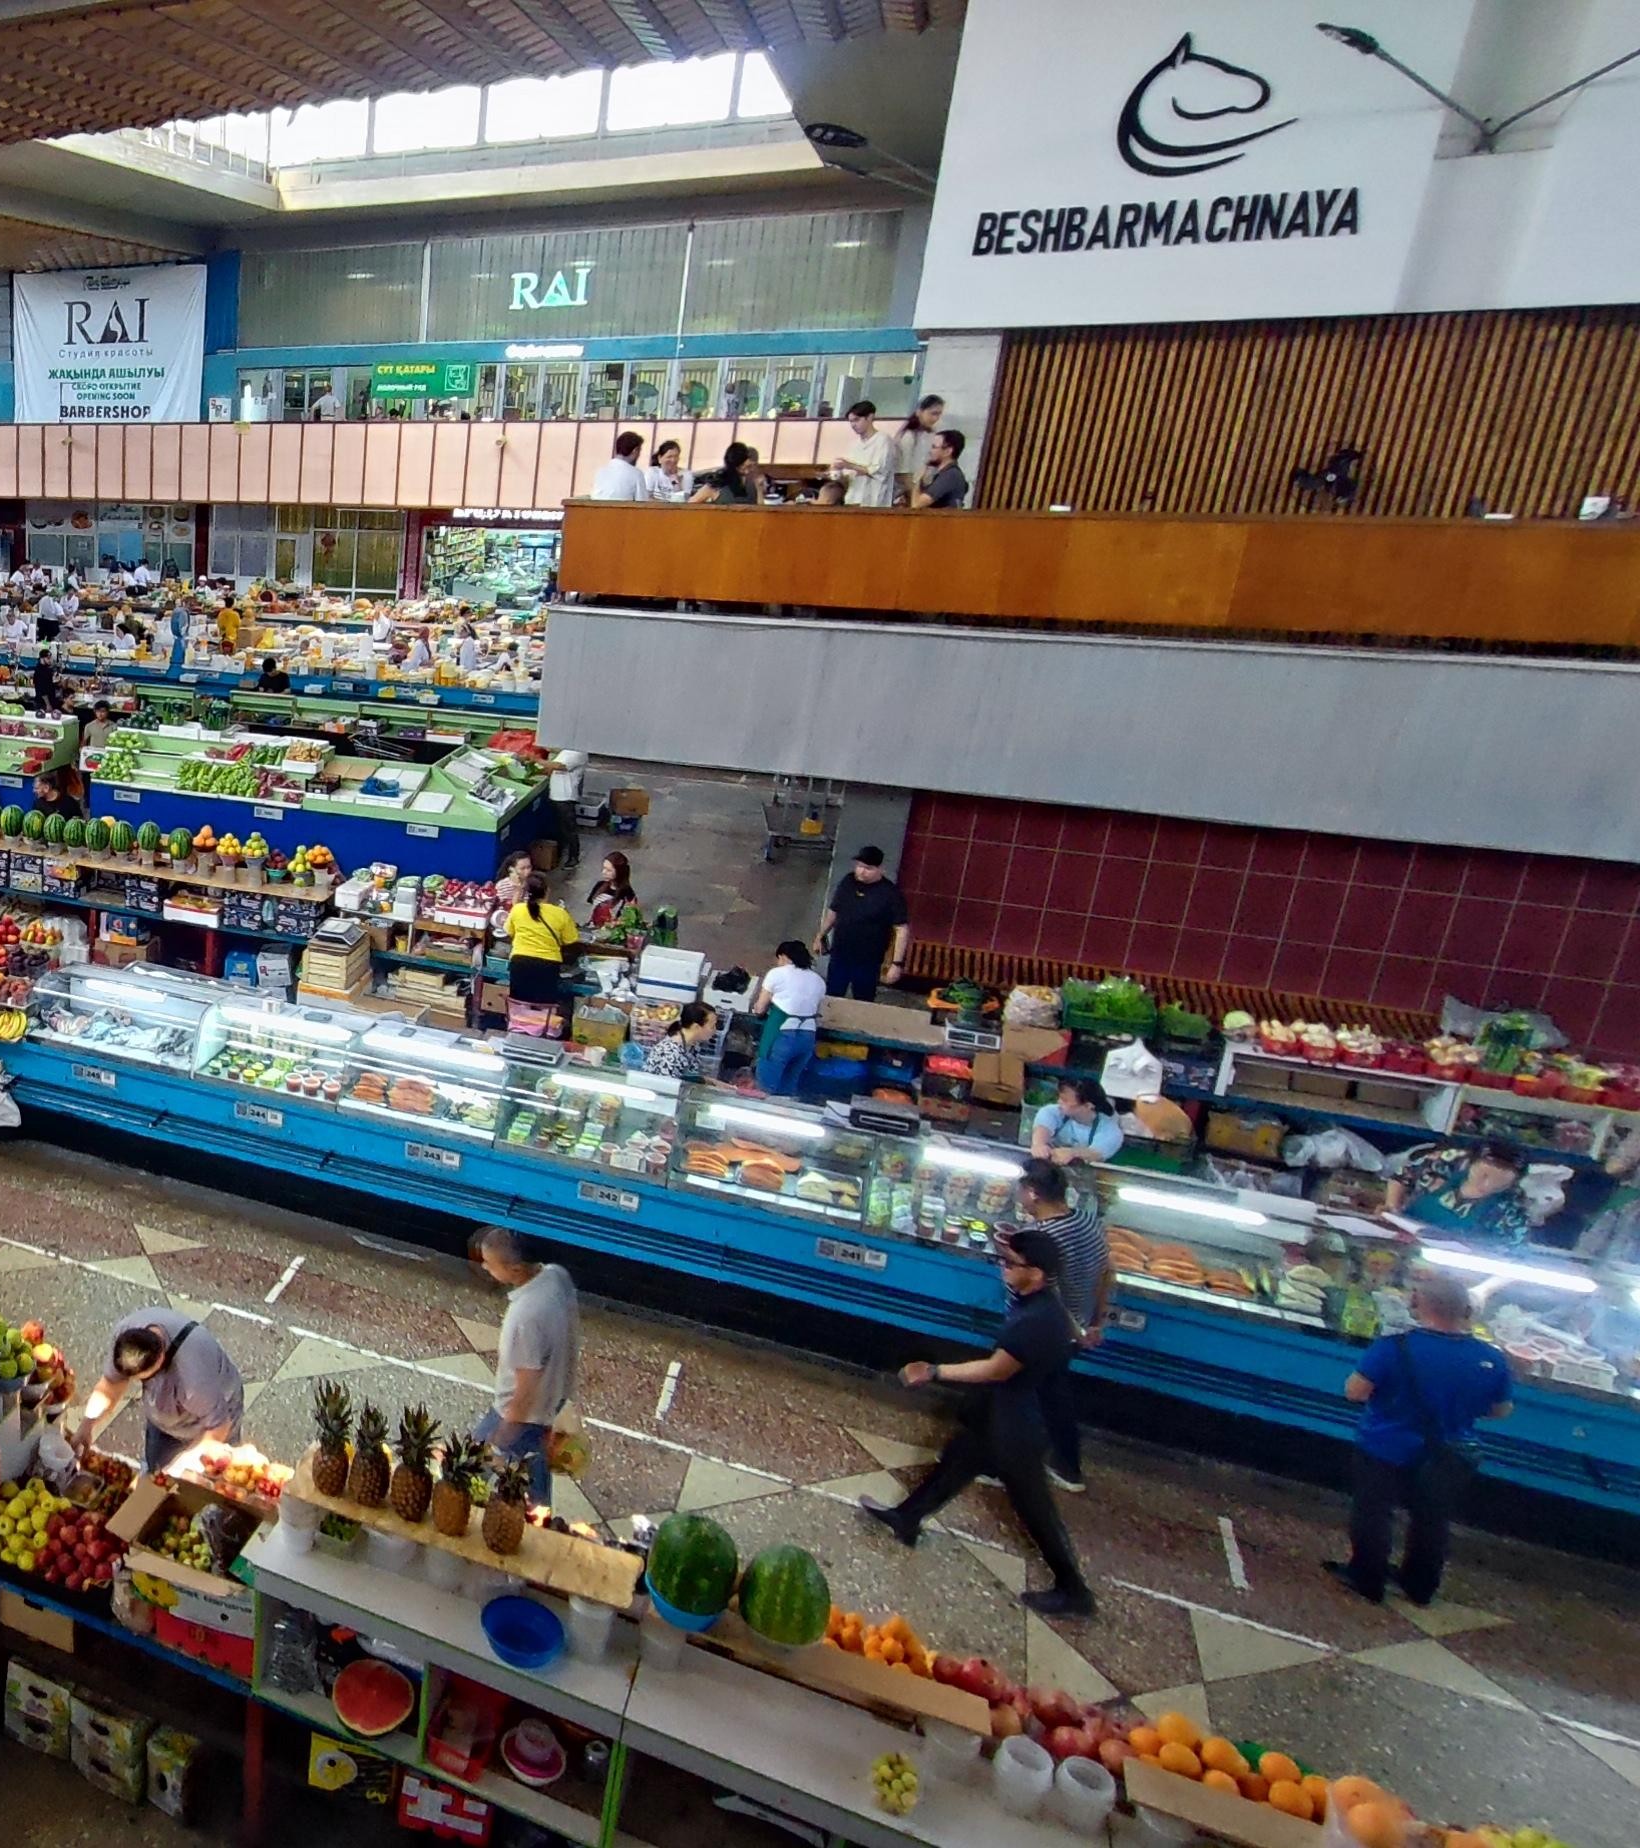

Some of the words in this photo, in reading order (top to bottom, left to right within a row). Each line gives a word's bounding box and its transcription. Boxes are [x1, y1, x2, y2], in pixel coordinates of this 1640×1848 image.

[972, 187, 1359, 256] BESHBARMACHNAYA
[509, 268, 591, 310] RAI
[63, 298, 150, 346] RAI
[58, 349, 100, 360] Студия
[104, 348, 153, 357] красоты
[48, 368, 106, 381] ЖАҚЫНДА
[109, 367, 165, 379] АШЫЛУЫ
[71, 382, 98, 391] СКОРО
[99, 382, 142, 391] ОТКРЫТИЕ
[76, 393, 110, 401] OPENING
[112, 392, 136, 401] SOON
[60, 405, 151, 419] BARBERSHOP
[250, 1109, 266, 1119] 244
[423, 1150, 441, 1161] 243
[599, 1190, 618, 1202] 242
[840, 1248, 861, 1260] 241
